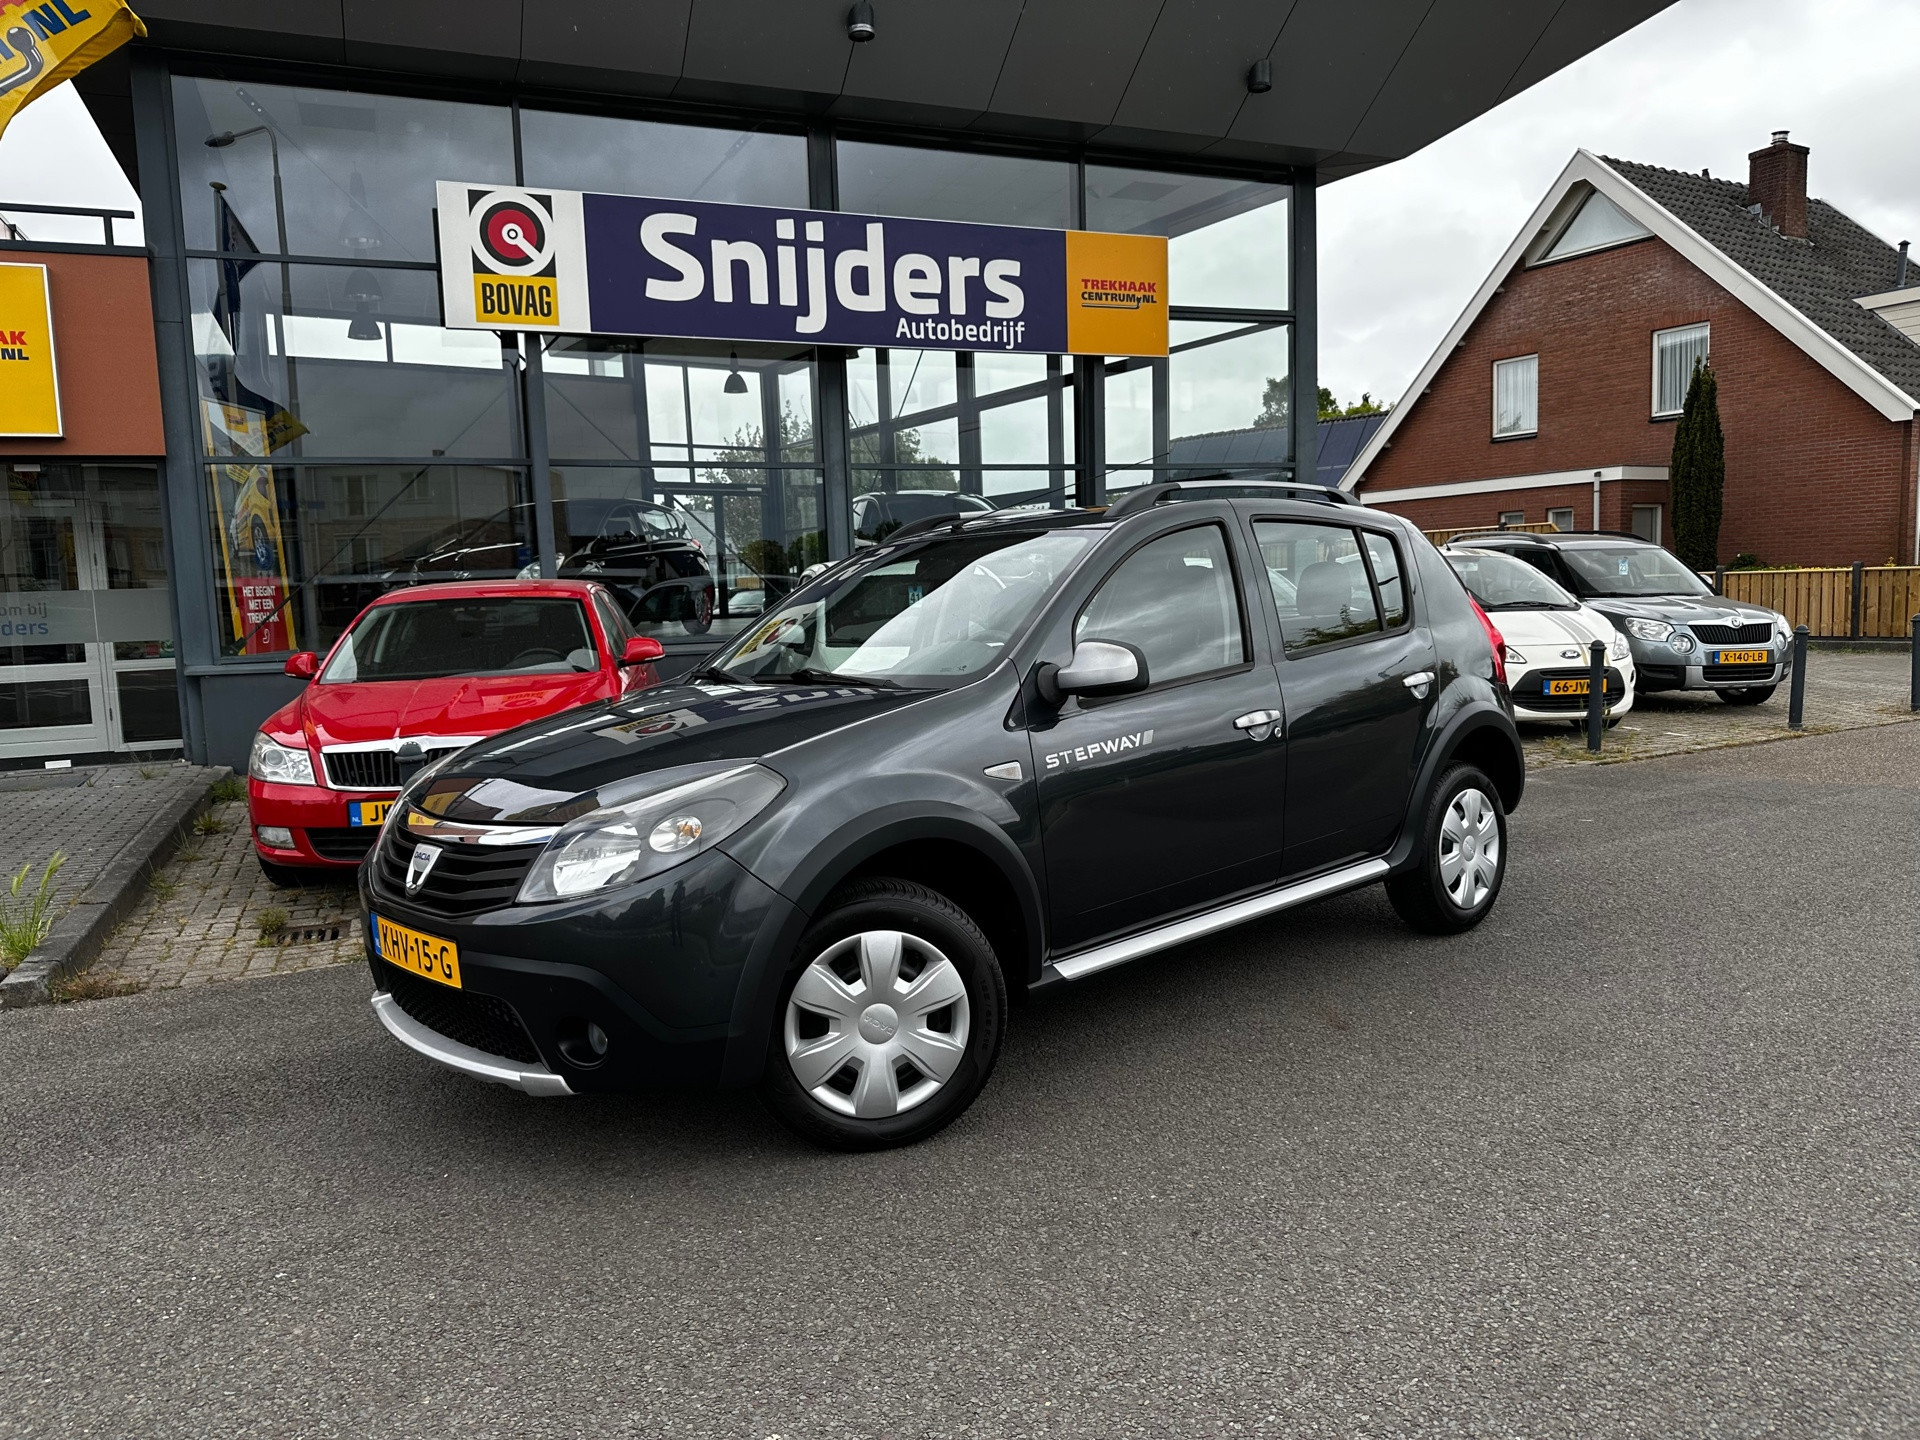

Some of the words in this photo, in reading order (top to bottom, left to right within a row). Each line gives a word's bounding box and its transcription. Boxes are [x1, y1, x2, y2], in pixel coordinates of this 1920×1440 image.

[639, 212, 1026, 334] Snijders
[1081, 278, 1157, 293] TREKHAAK
[481, 282, 552, 318] BOVAG
[895, 317, 1026, 350] Autobedrijf
[242, 585, 254, 597] HET
[255, 585, 276, 597] BEGINT
[28, 602, 47, 619] bij
[248, 599, 261, 610] MET
[262, 598, 275, 610] EEN
[247, 611, 280, 624] TREKHAK
[1723, 651, 1764, 662] X-140-LB
[1045, 732, 1141, 769] STEPWAY
[414, 851, 431, 861] DACIA
[381, 923, 453, 980] KHV-15-G
